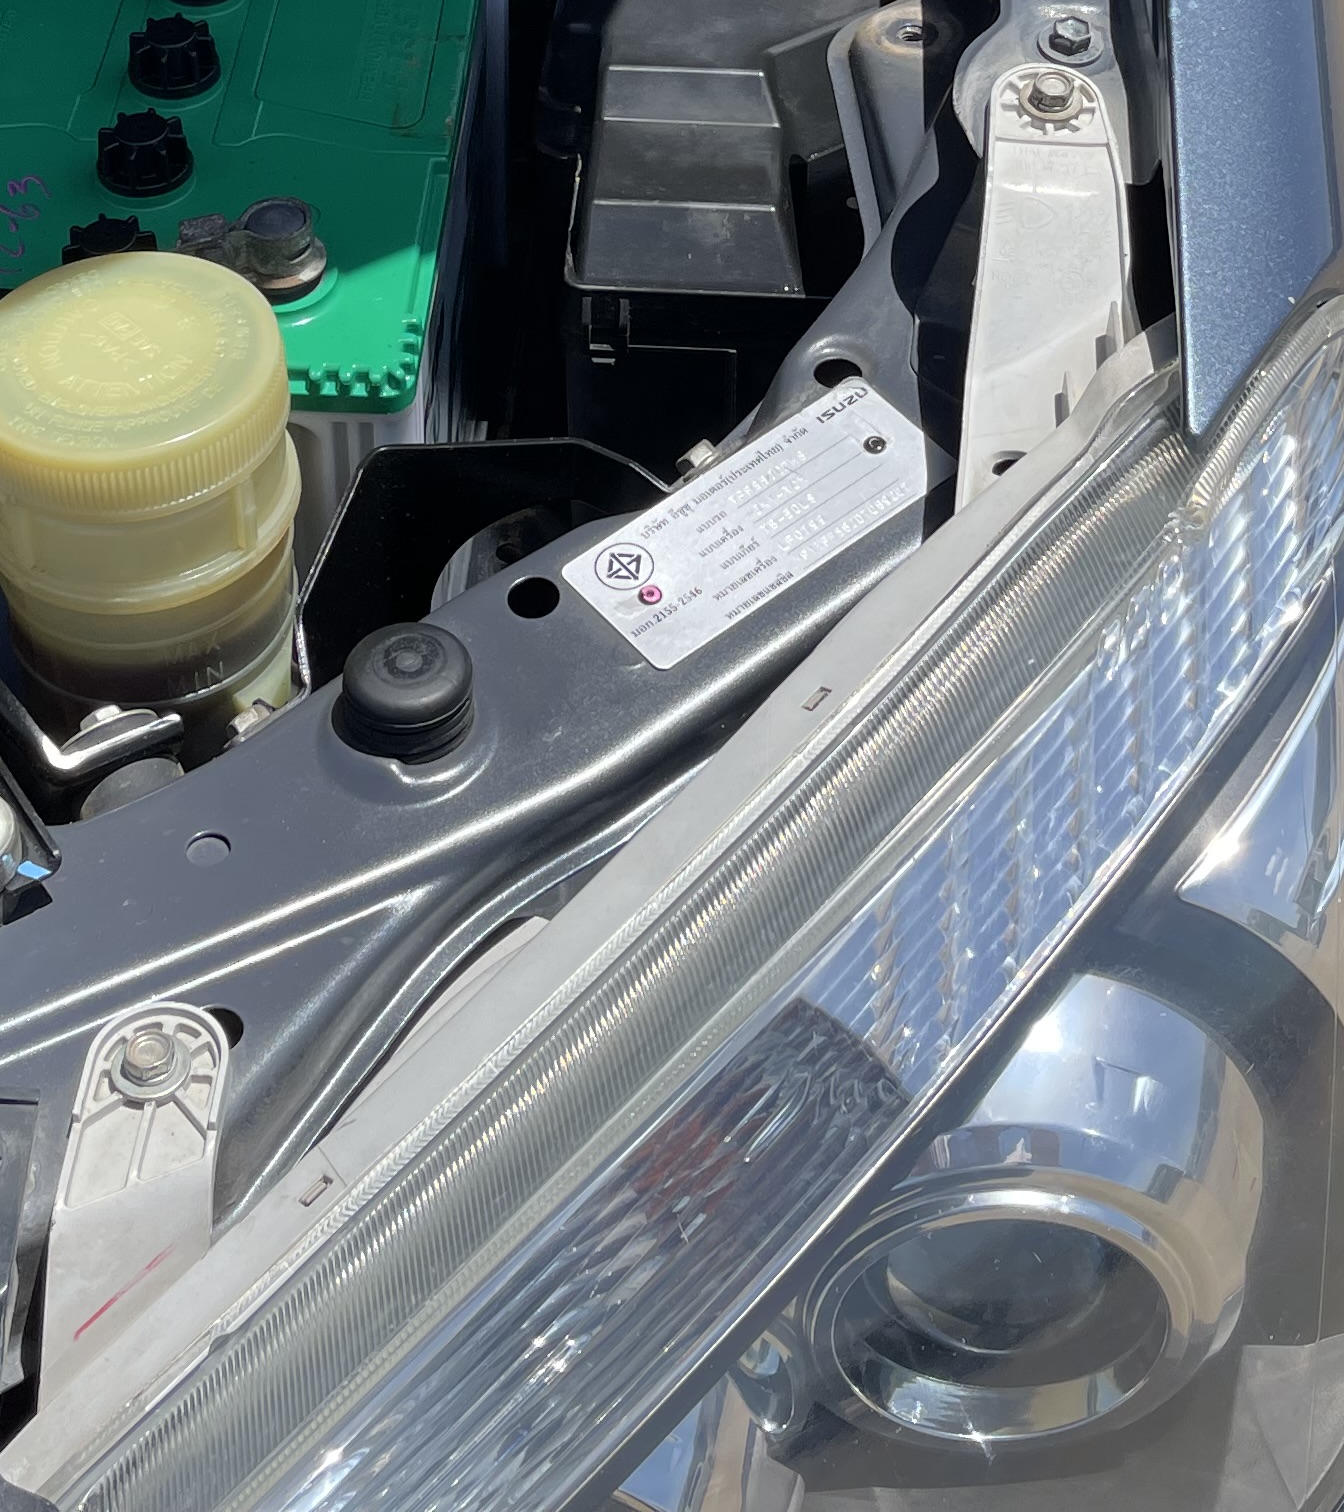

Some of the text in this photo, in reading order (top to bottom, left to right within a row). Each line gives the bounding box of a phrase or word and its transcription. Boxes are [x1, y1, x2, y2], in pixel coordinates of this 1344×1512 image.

[815, 386, 870, 424] ISUZU
[639, 513, 670, 540] บริษัท
[785, 426, 810, 448] จำกัด
